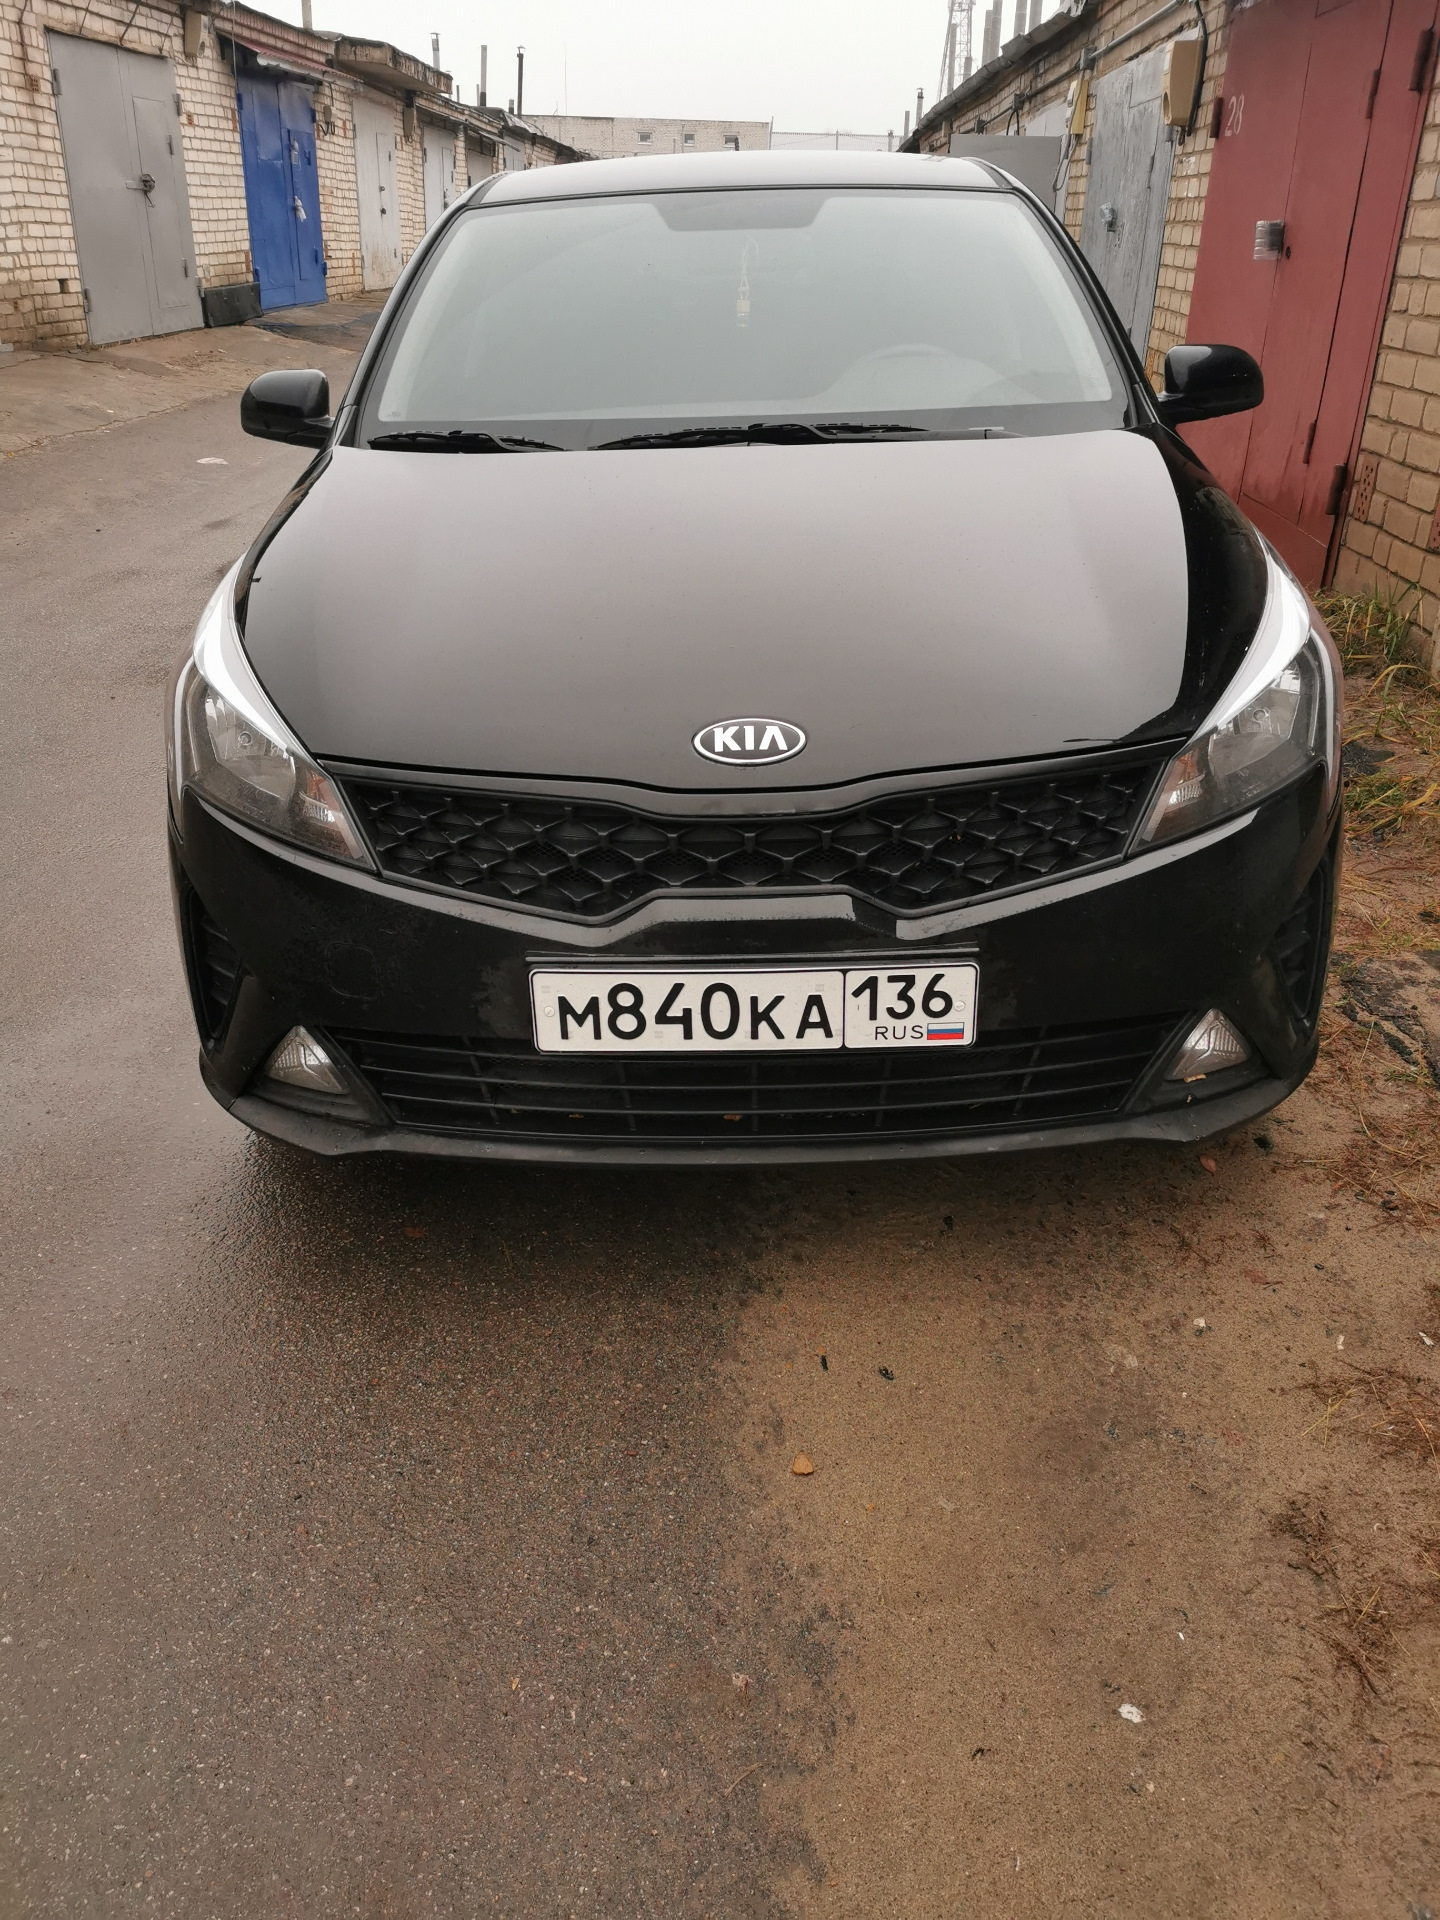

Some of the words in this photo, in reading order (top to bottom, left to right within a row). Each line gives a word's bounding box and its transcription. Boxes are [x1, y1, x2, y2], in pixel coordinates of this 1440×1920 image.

[1224, 93, 1245, 137] 28
[713, 725, 788, 752] KIA
[851, 973, 954, 1021] 136
[875, 1024, 924, 1040] RUS
